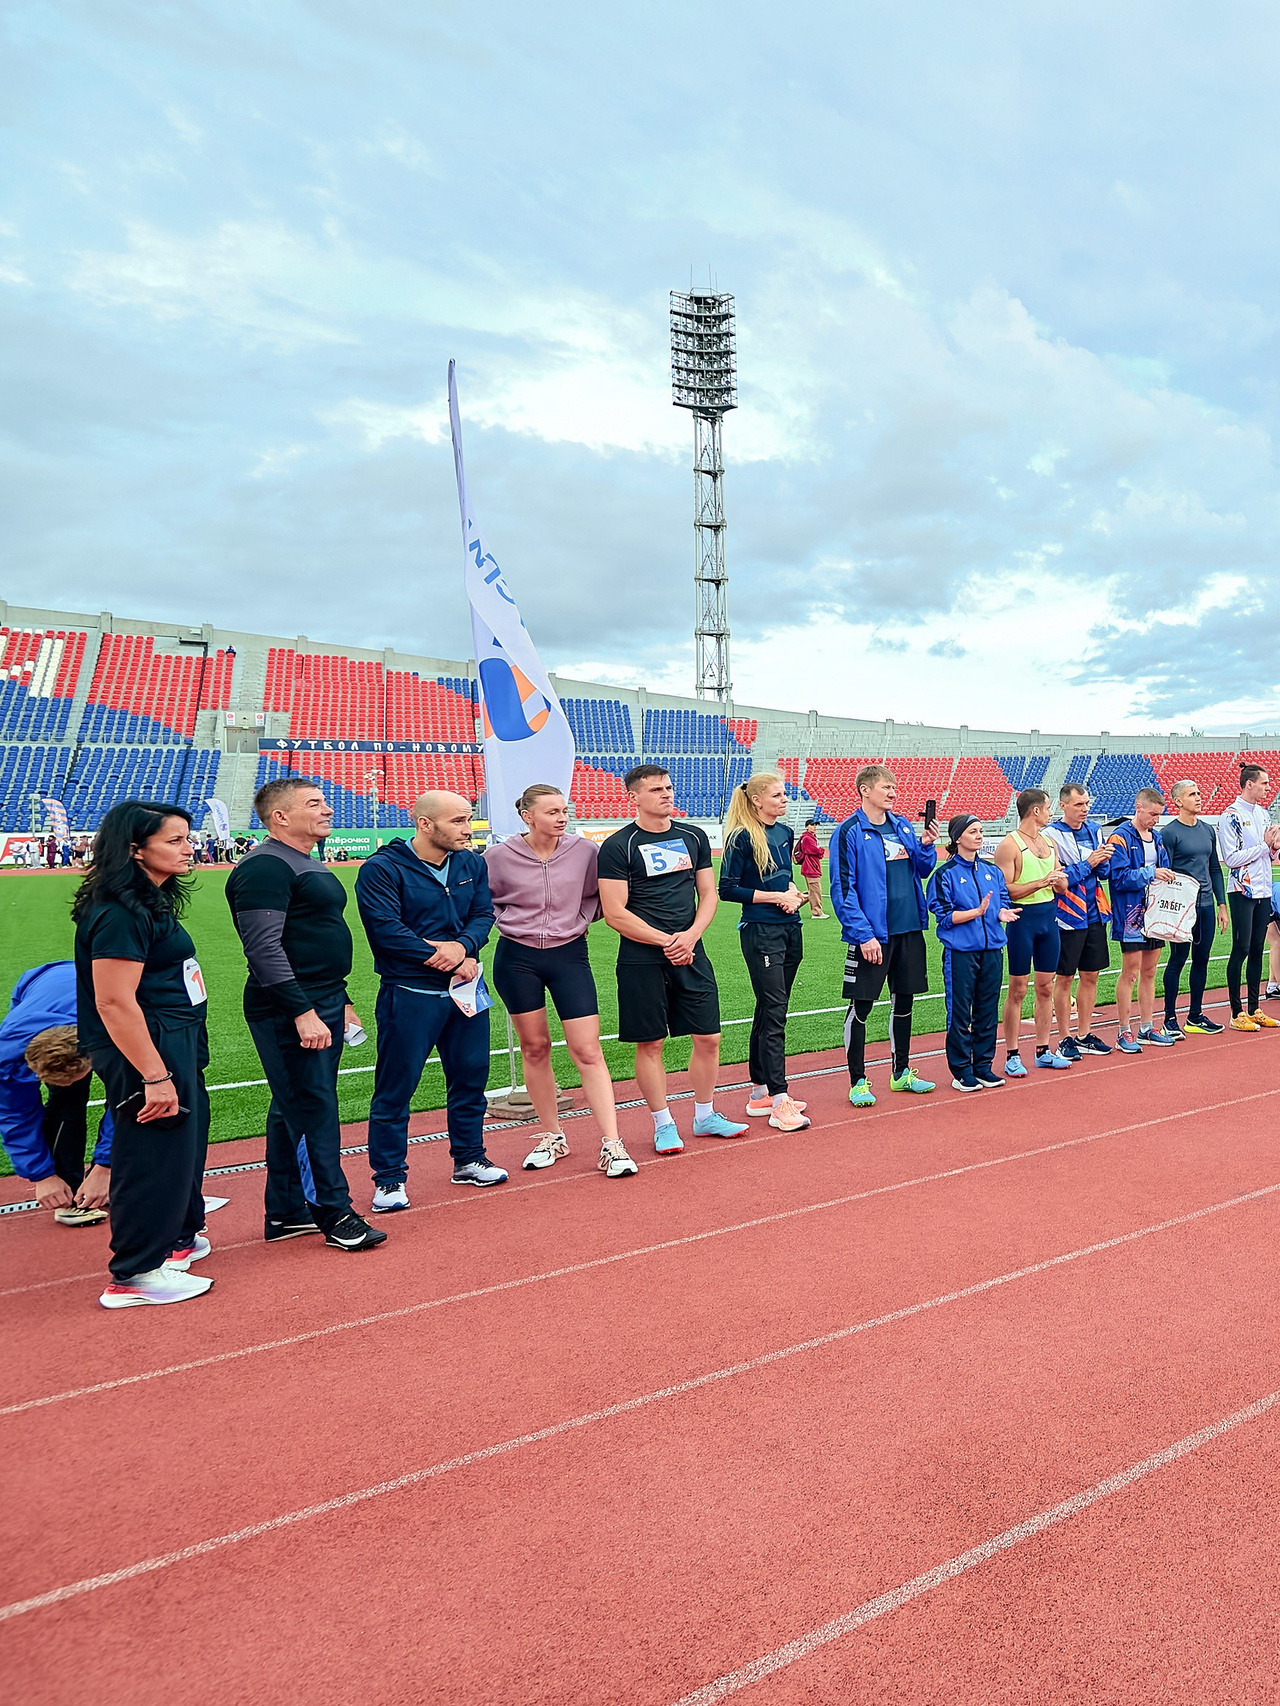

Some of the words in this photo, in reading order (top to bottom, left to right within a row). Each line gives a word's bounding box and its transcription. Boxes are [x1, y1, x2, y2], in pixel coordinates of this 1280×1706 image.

[276, 740, 359, 751] ФУТБОЛ
[373, 743, 484, 753] ПО-НОВОМУ
[325, 836, 370, 845] тёрочка
[650, 852, 667, 872] 5
[1159, 900, 1169, 910] ЗА
[1170, 901, 1182, 912] БЕГ
